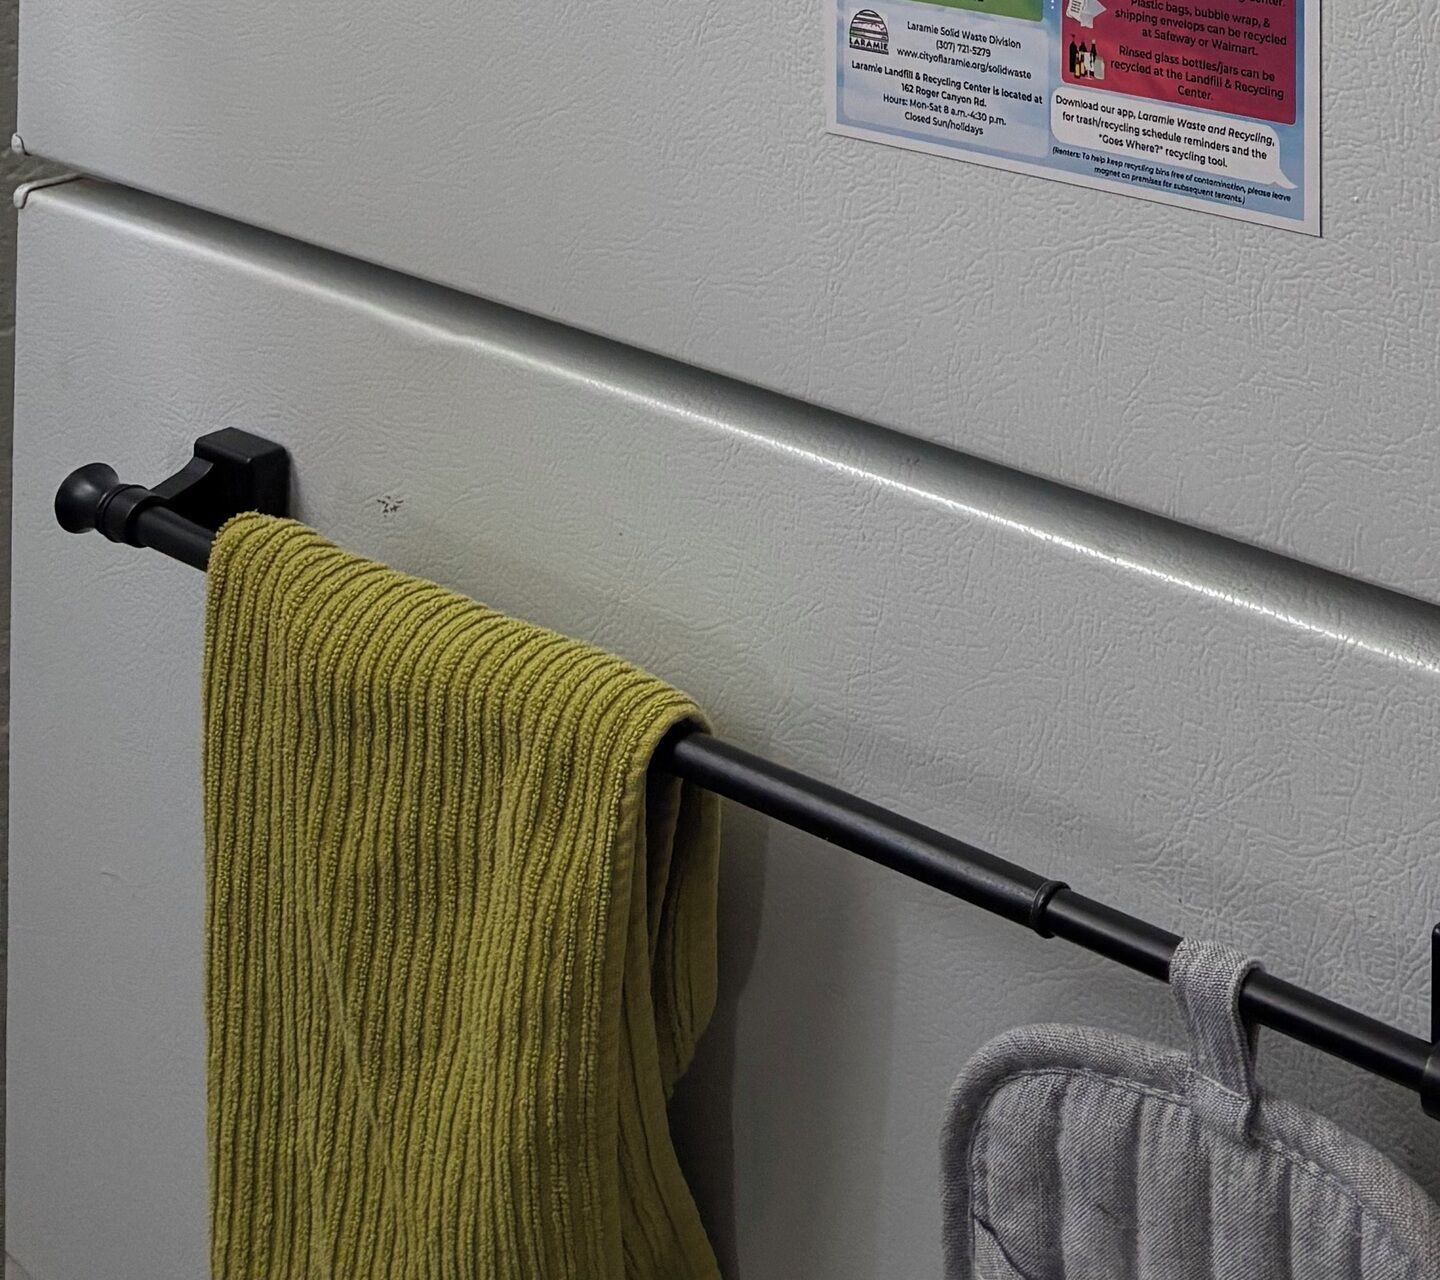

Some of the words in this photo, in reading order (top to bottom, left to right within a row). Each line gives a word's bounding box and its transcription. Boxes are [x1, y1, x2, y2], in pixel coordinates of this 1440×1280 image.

[907, 21, 939, 34] Laramie
[940, 27, 960, 38] Solid
[962, 31, 987, 42] Waste
[989, 35, 1021, 49] Division
[936, 40, 955, 51] (307)
[957, 44, 991, 57] 721-5279
[897, 48, 1032, 79] www.cityoflaramie.org/solidwaste
